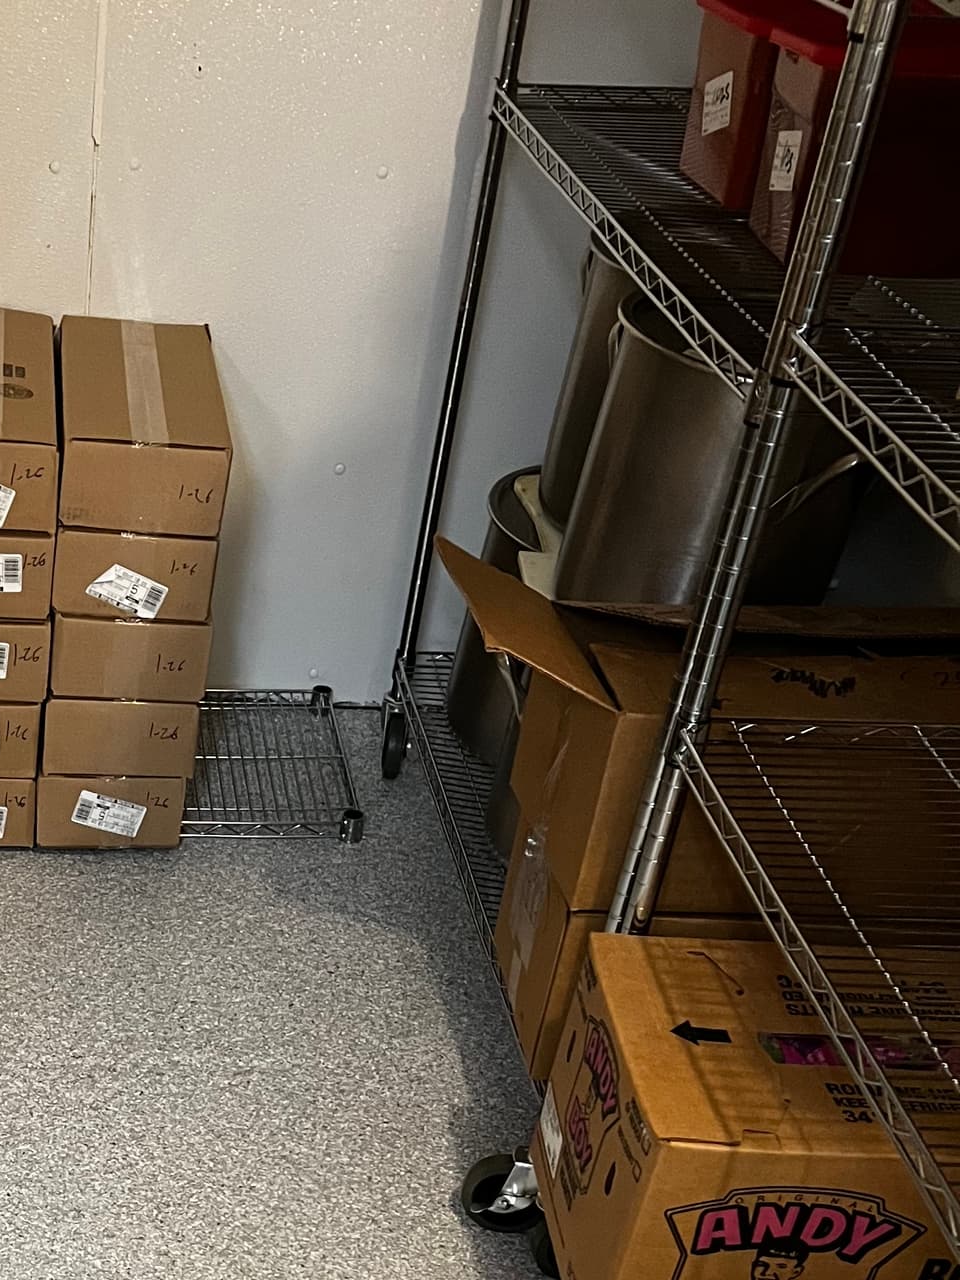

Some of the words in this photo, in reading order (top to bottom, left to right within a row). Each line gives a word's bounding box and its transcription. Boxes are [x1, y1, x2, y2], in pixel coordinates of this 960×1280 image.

[584, 1020, 619, 1122] ANDY
[569, 1096, 593, 1173] BOY
[690, 1202, 902, 1264] ANDY
[735, 1194, 874, 1213] ORIGINAL
